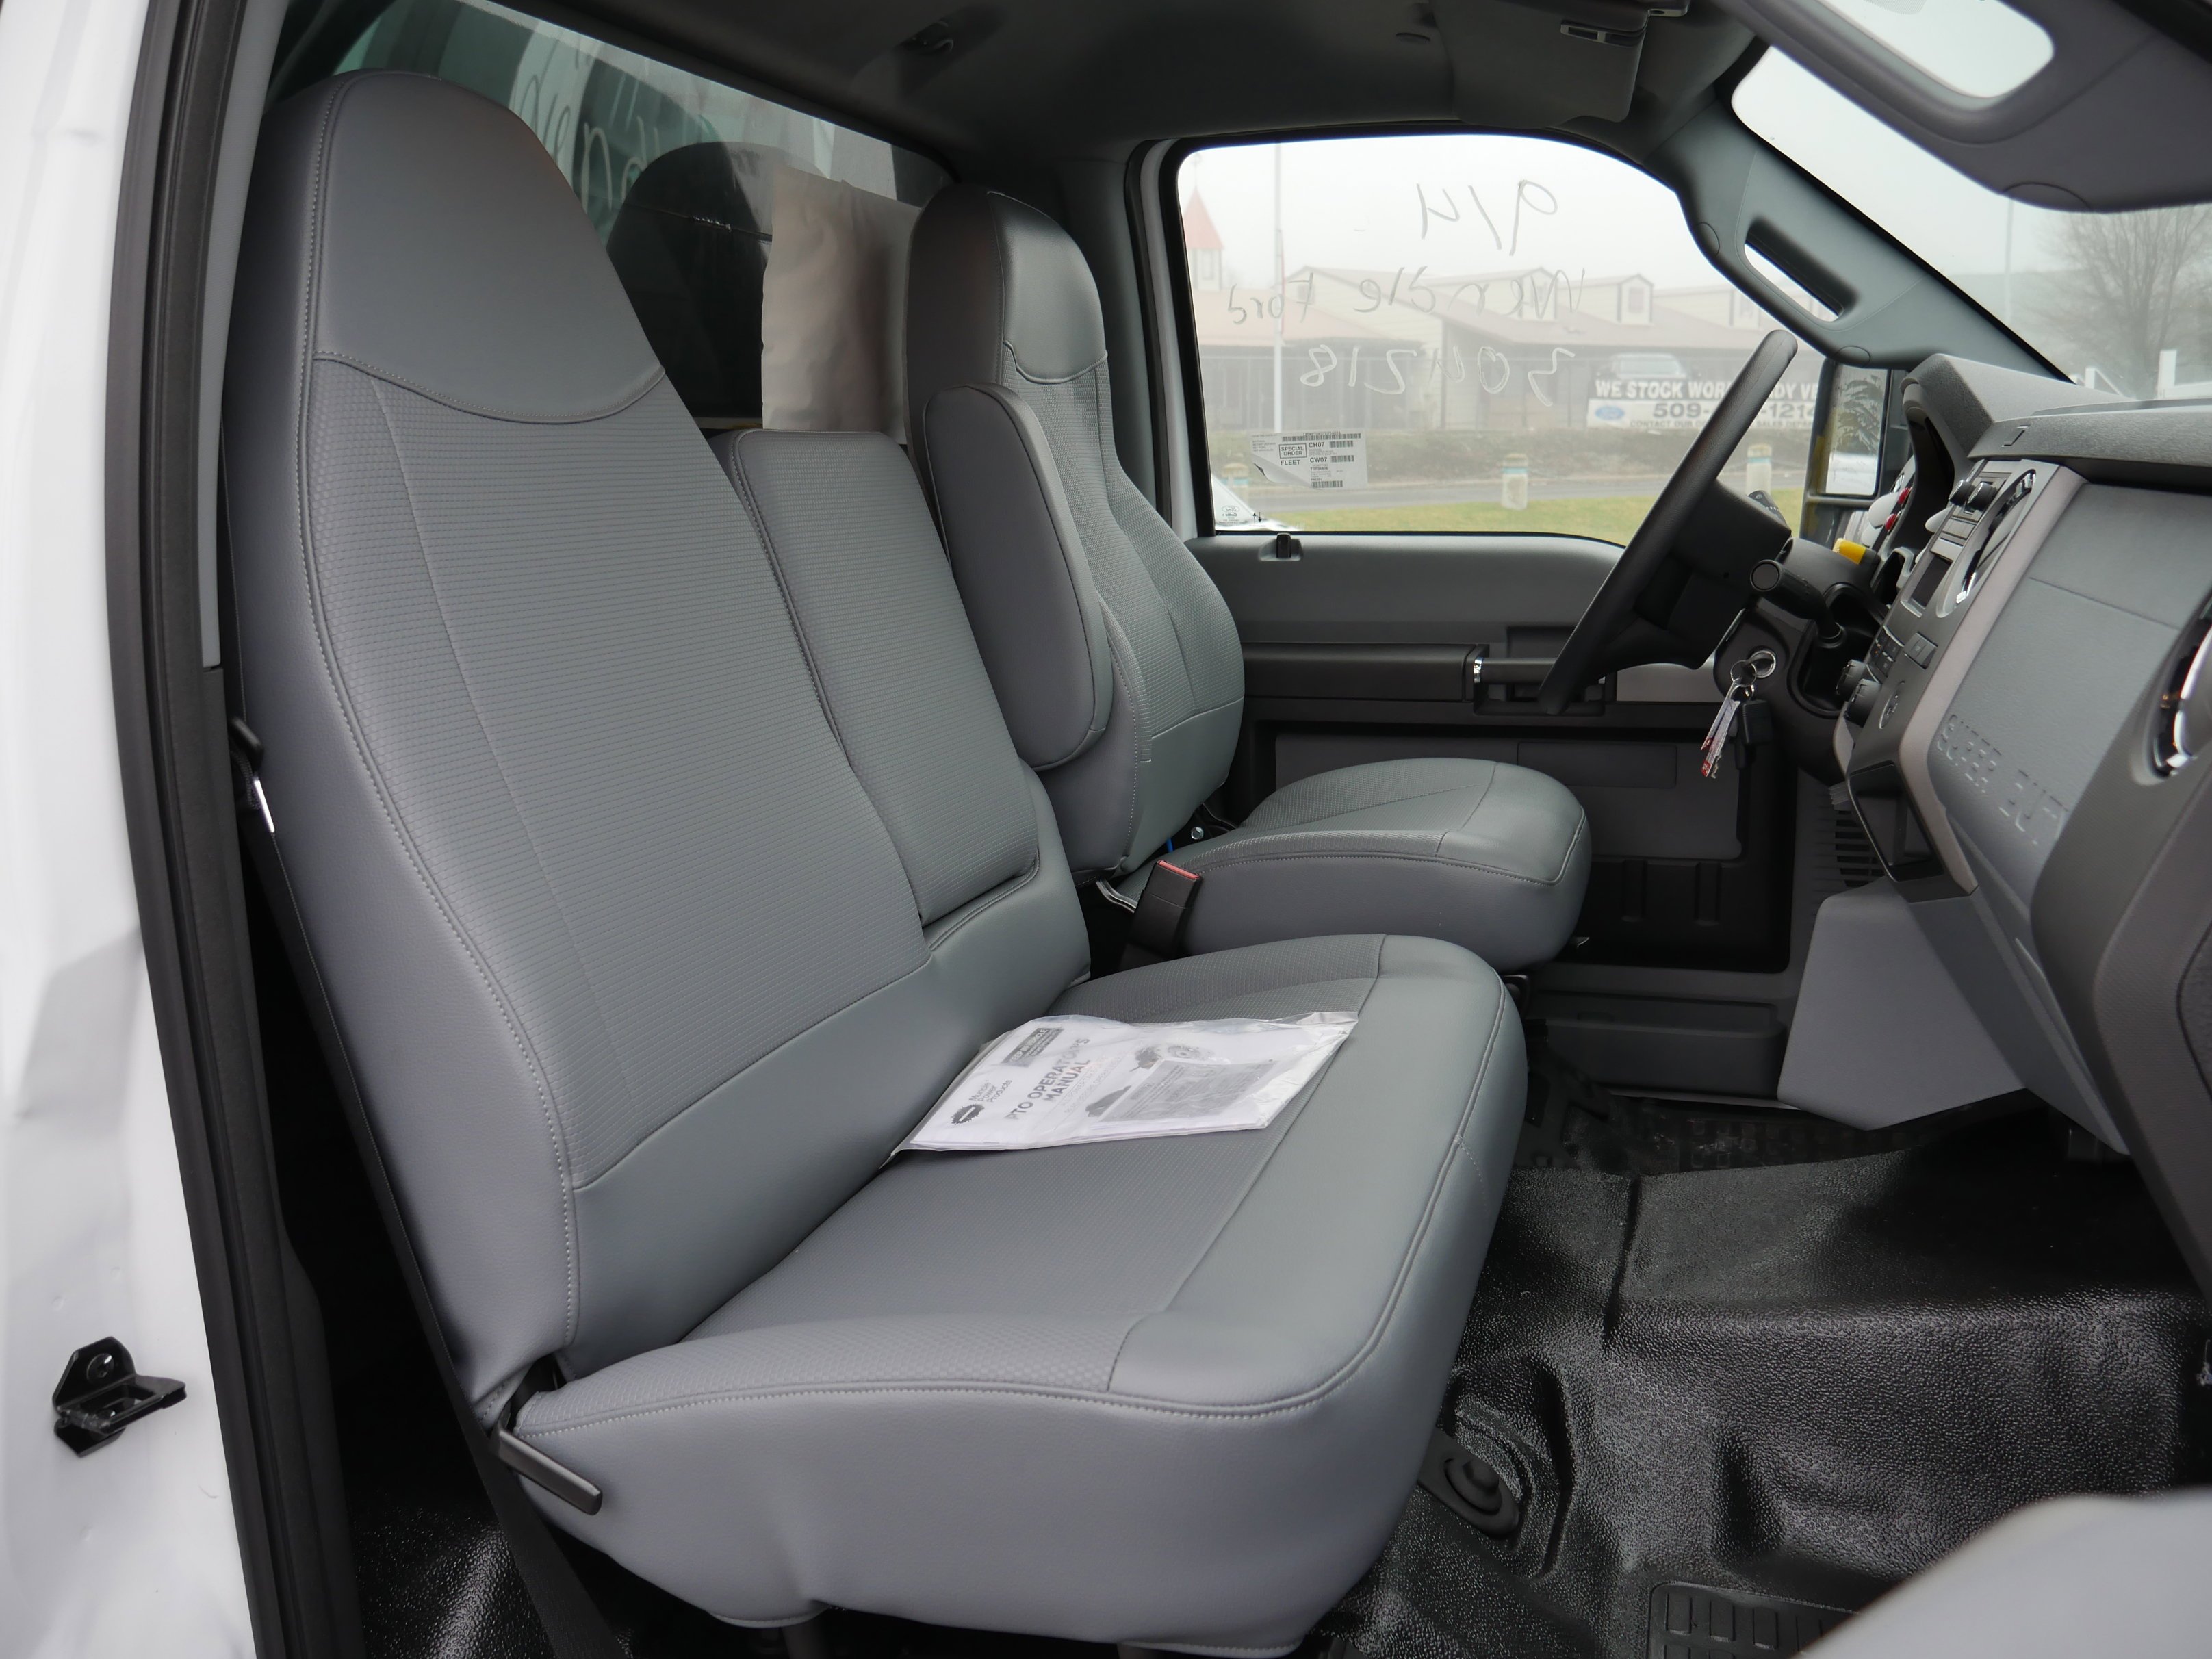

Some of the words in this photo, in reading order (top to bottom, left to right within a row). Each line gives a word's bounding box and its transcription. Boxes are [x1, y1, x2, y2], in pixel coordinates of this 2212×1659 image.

[1595, 381, 1621, 398] WE
[1627, 381, 1683, 399] STOCK
[1688, 381, 1732, 399] WOR
[1042, 1059, 1090, 1101] MANUAL
[986, 1080, 1013, 1103] Products
[1003, 1101, 1033, 1120] PTO
